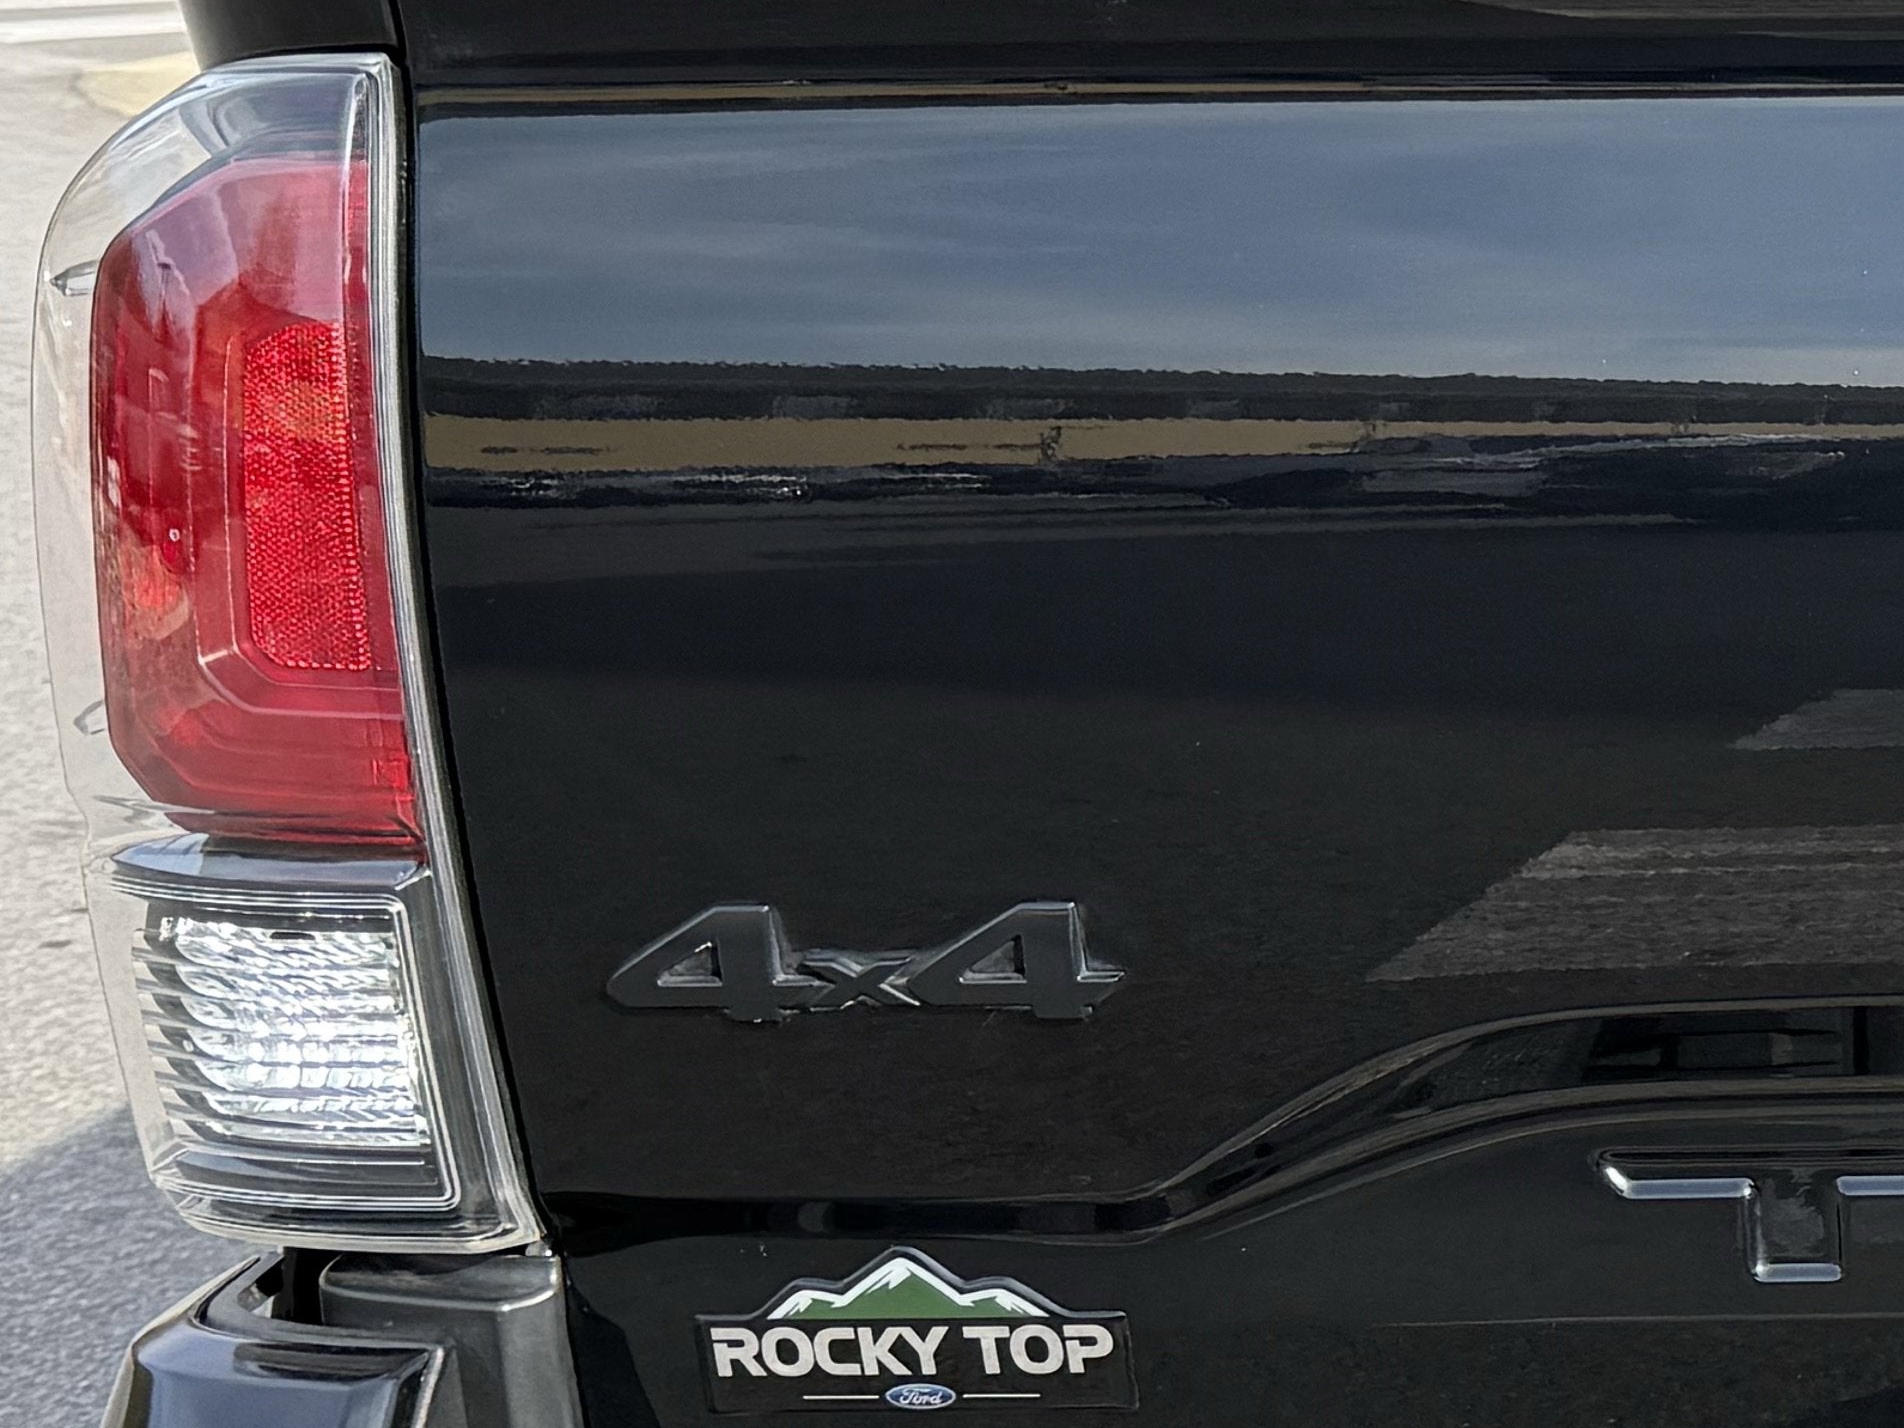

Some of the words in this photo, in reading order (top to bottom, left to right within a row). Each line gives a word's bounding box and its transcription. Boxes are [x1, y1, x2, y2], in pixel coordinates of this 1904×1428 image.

[710, 1326, 950, 1377] ROCKY
[962, 1324, 1115, 1375] TOP
[899, 1388, 943, 1406] Ford
